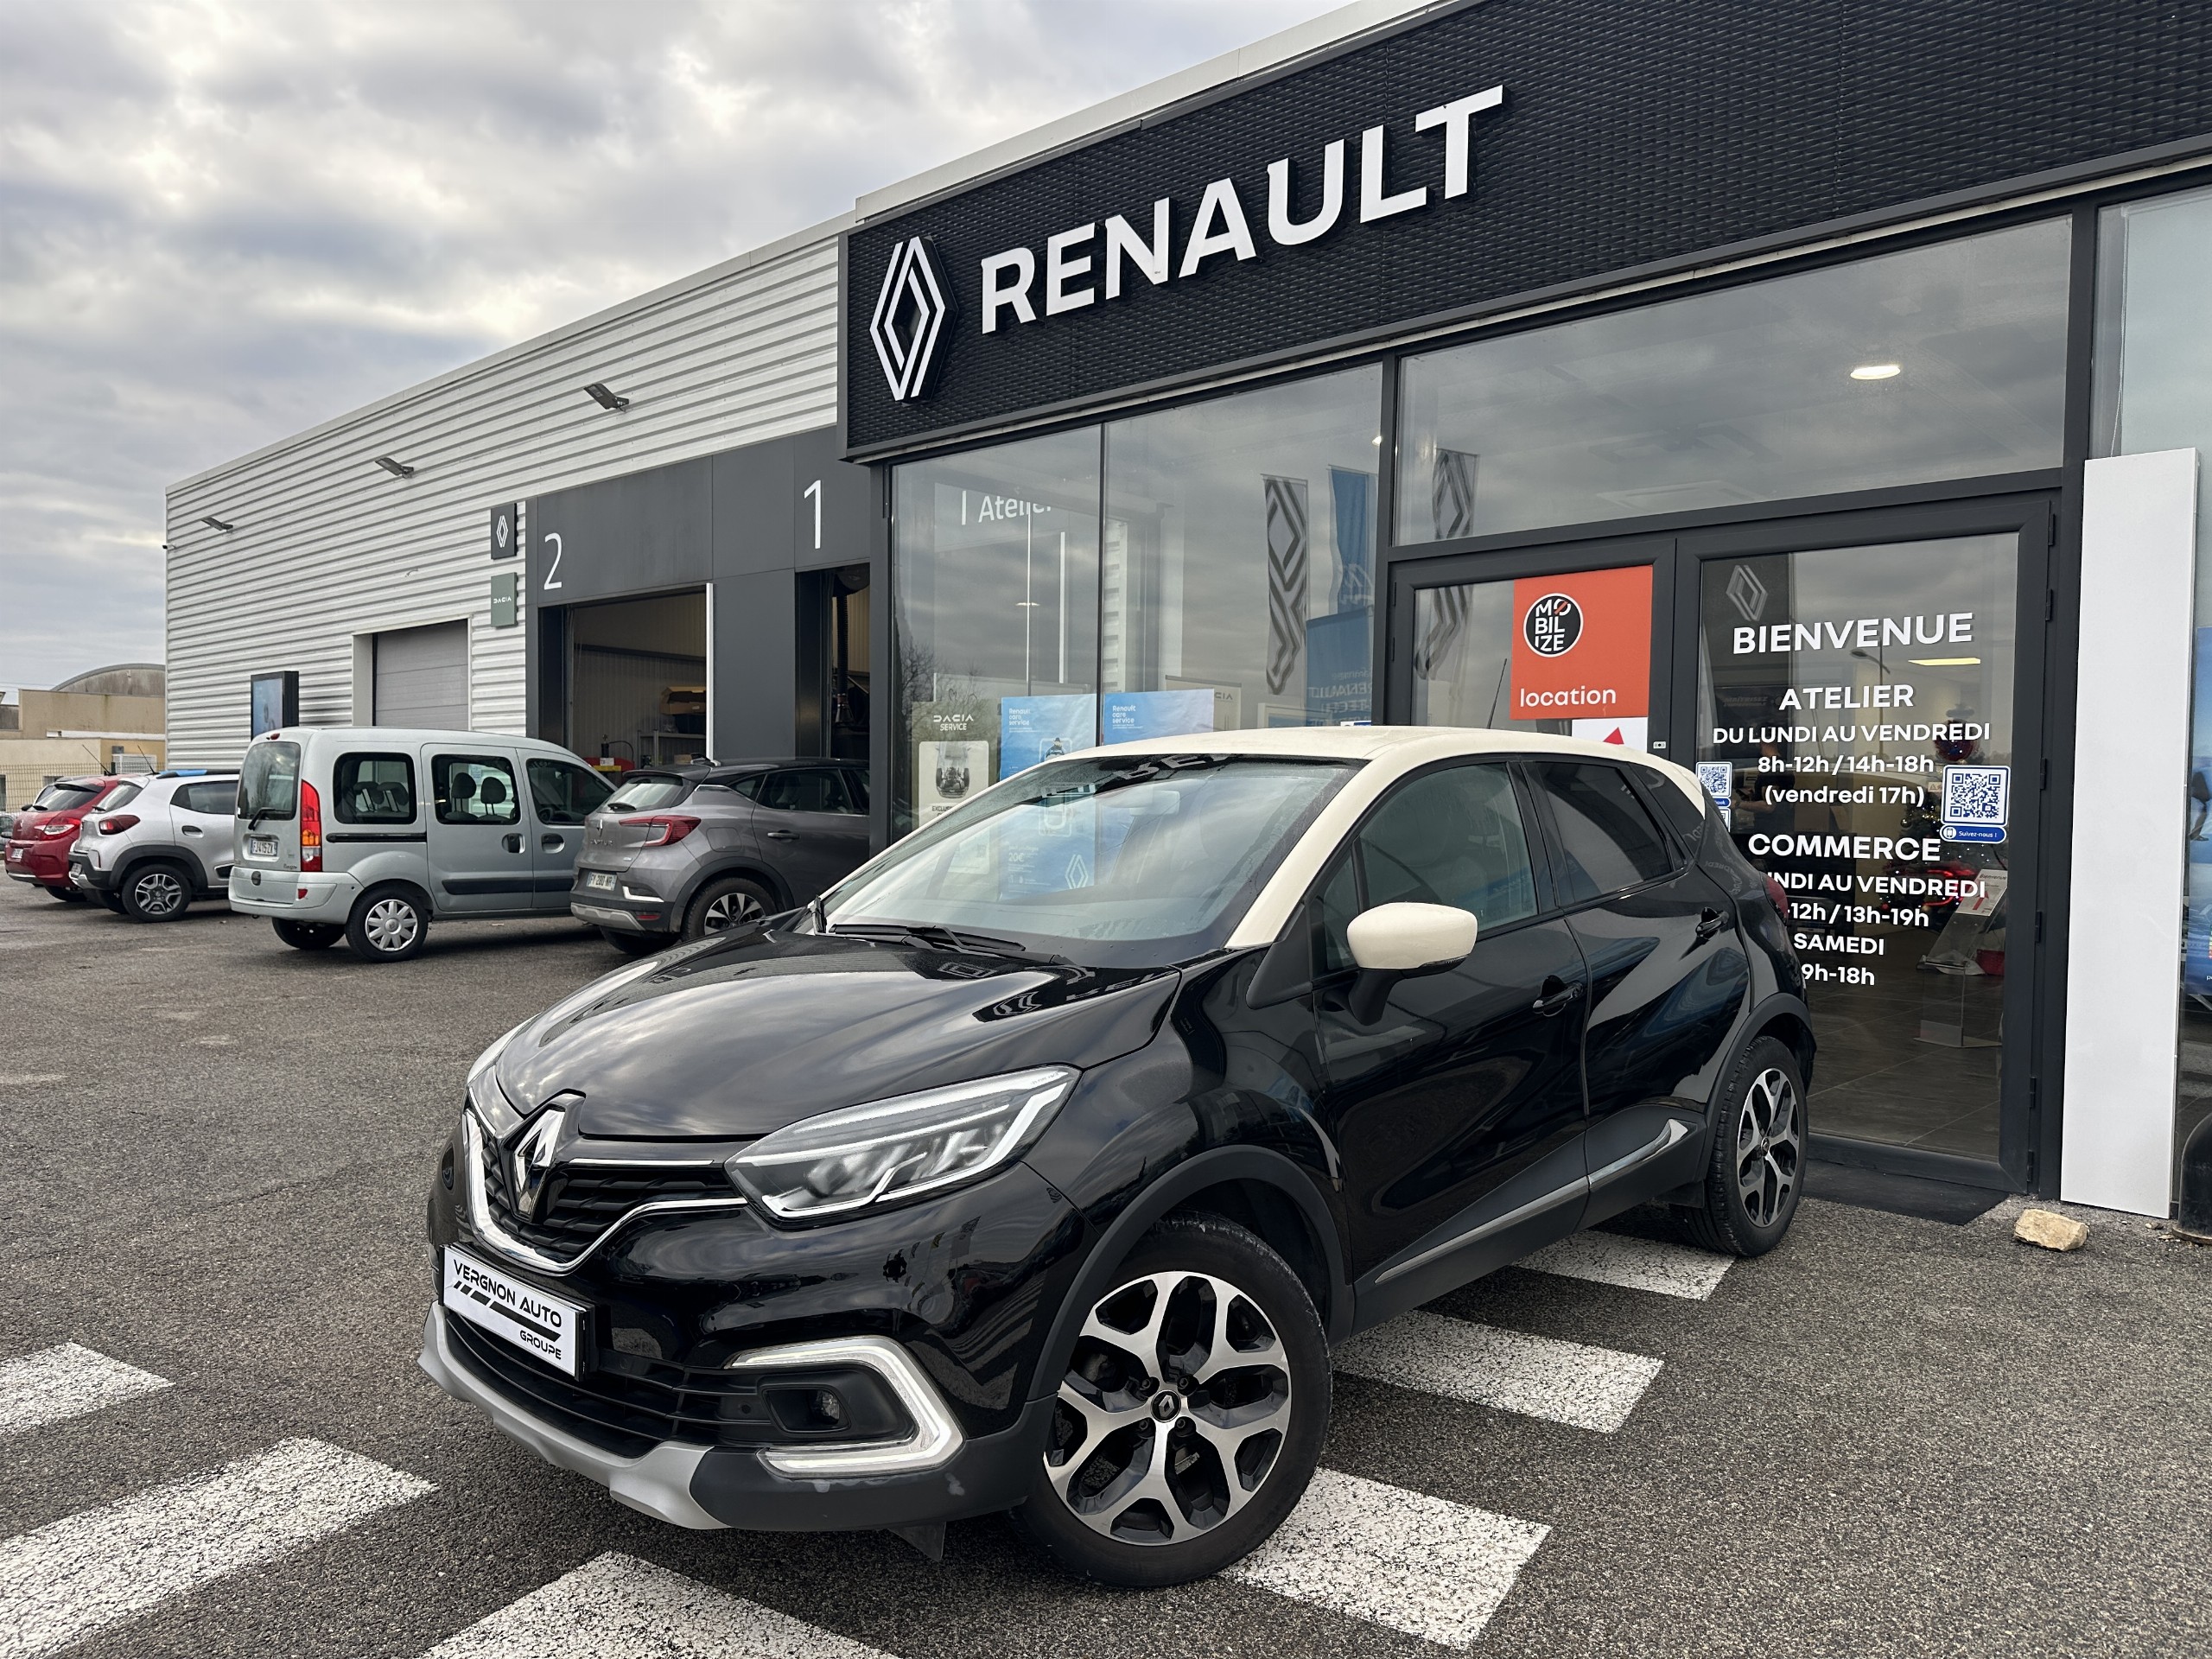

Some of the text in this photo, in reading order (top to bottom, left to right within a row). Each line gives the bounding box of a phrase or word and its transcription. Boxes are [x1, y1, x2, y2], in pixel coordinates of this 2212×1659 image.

[982, 84, 1503, 334] RENAULT
[804, 480, 822, 550] 1
[543, 532, 563, 590] 2
[493, 595, 512, 604] DACIA
[1732, 612, 1974, 654] BIENVENUE
[1520, 684, 1617, 708] location
[1778, 684, 1915, 711] ATELIER
[933, 714, 975, 723] DACIA
[939, 722, 968, 732] SERVICE
[1713, 722, 1991, 744] DU LUNDI AU VENDREDI
[1758, 755, 1829, 773] 8h-12h
[1847, 754, 1935, 773] 14h-18h
[1764, 785, 1925, 807] (vendredi 17h)
[1748, 833, 1942, 861] COMMERCE
[1768, 872, 1986, 899] NDI AU VENDREDI
[1844, 906, 1929, 927] 13h-19h
[1794, 932, 1885, 956] SAMEDI
[1801, 963, 1876, 986] 9h-18h
[454, 1259, 563, 1328] VERGNON AUTO
[520, 1330, 562, 1360] GROUPE
